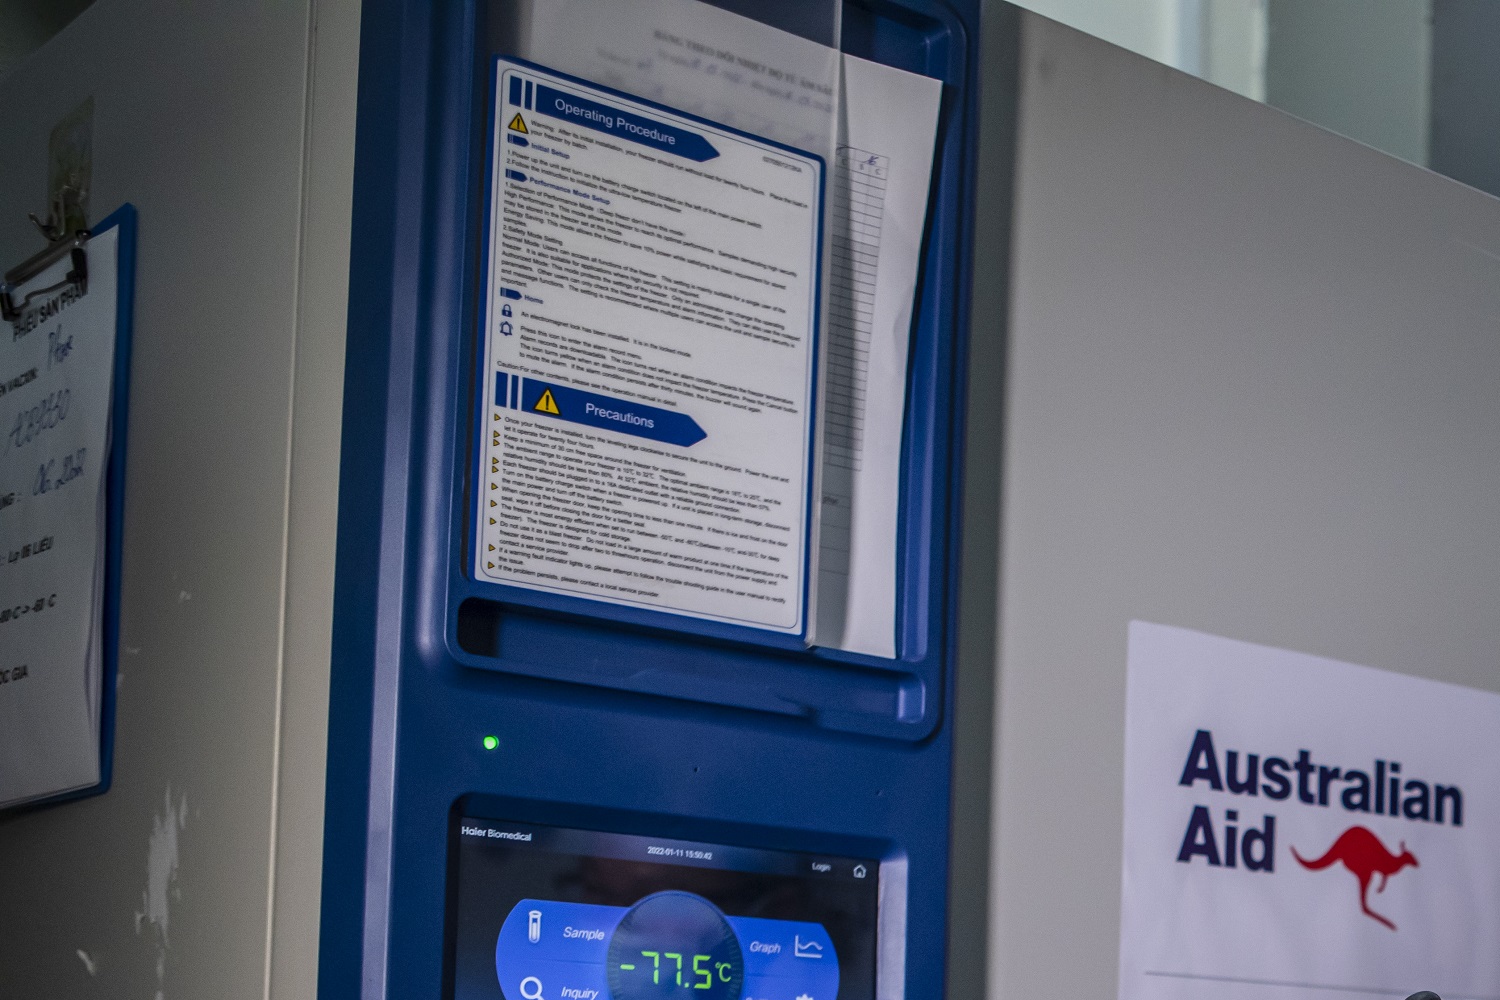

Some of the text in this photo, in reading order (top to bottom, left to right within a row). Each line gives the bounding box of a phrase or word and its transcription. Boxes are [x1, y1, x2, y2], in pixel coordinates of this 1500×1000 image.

[555, 98, 676, 145] Operating Procedure
[531, 141, 569, 160] Initial Setup
[529, 176, 610, 206] Performance Mode Setup
[524, 294, 543, 304] Home
[586, 402, 654, 428] Precautions
[1178, 730, 1463, 826] Australian
[461, 826, 532, 842] Haier Biomedical
[1176, 806, 1276, 872] Aid
[563, 926, 605, 942] Sample
[750, 941, 780, 954] Graph
